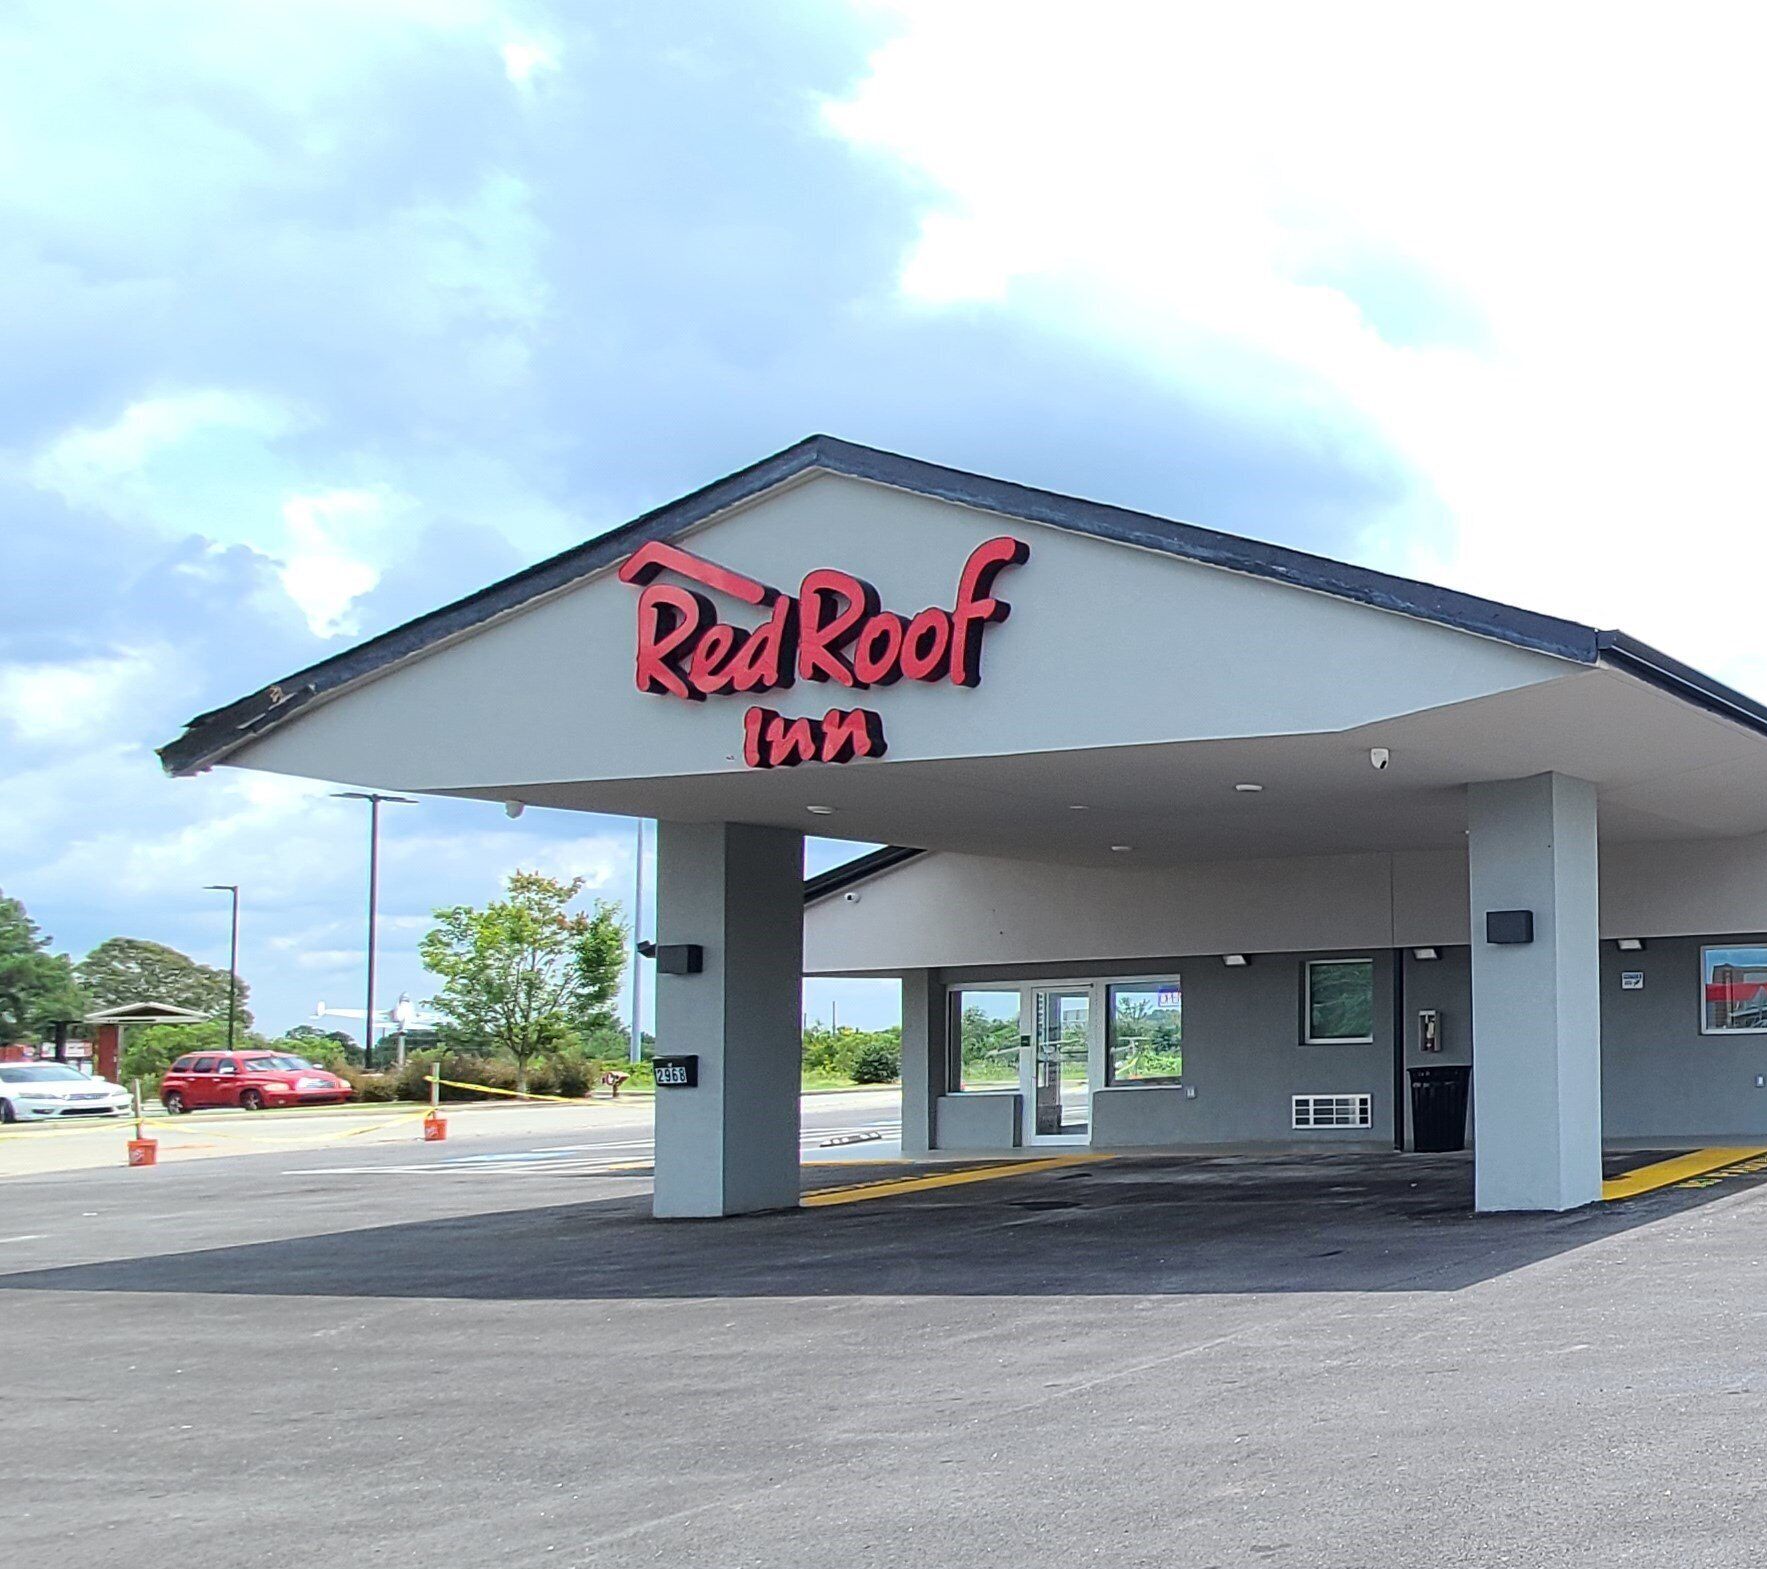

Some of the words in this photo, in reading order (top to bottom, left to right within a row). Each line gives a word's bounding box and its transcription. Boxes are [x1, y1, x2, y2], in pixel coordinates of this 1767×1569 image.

[636, 583, 797, 701] Red
[798, 536, 1030, 690] Roof
[744, 706, 888, 769] Inn
[657, 1068, 687, 1083] 2968
